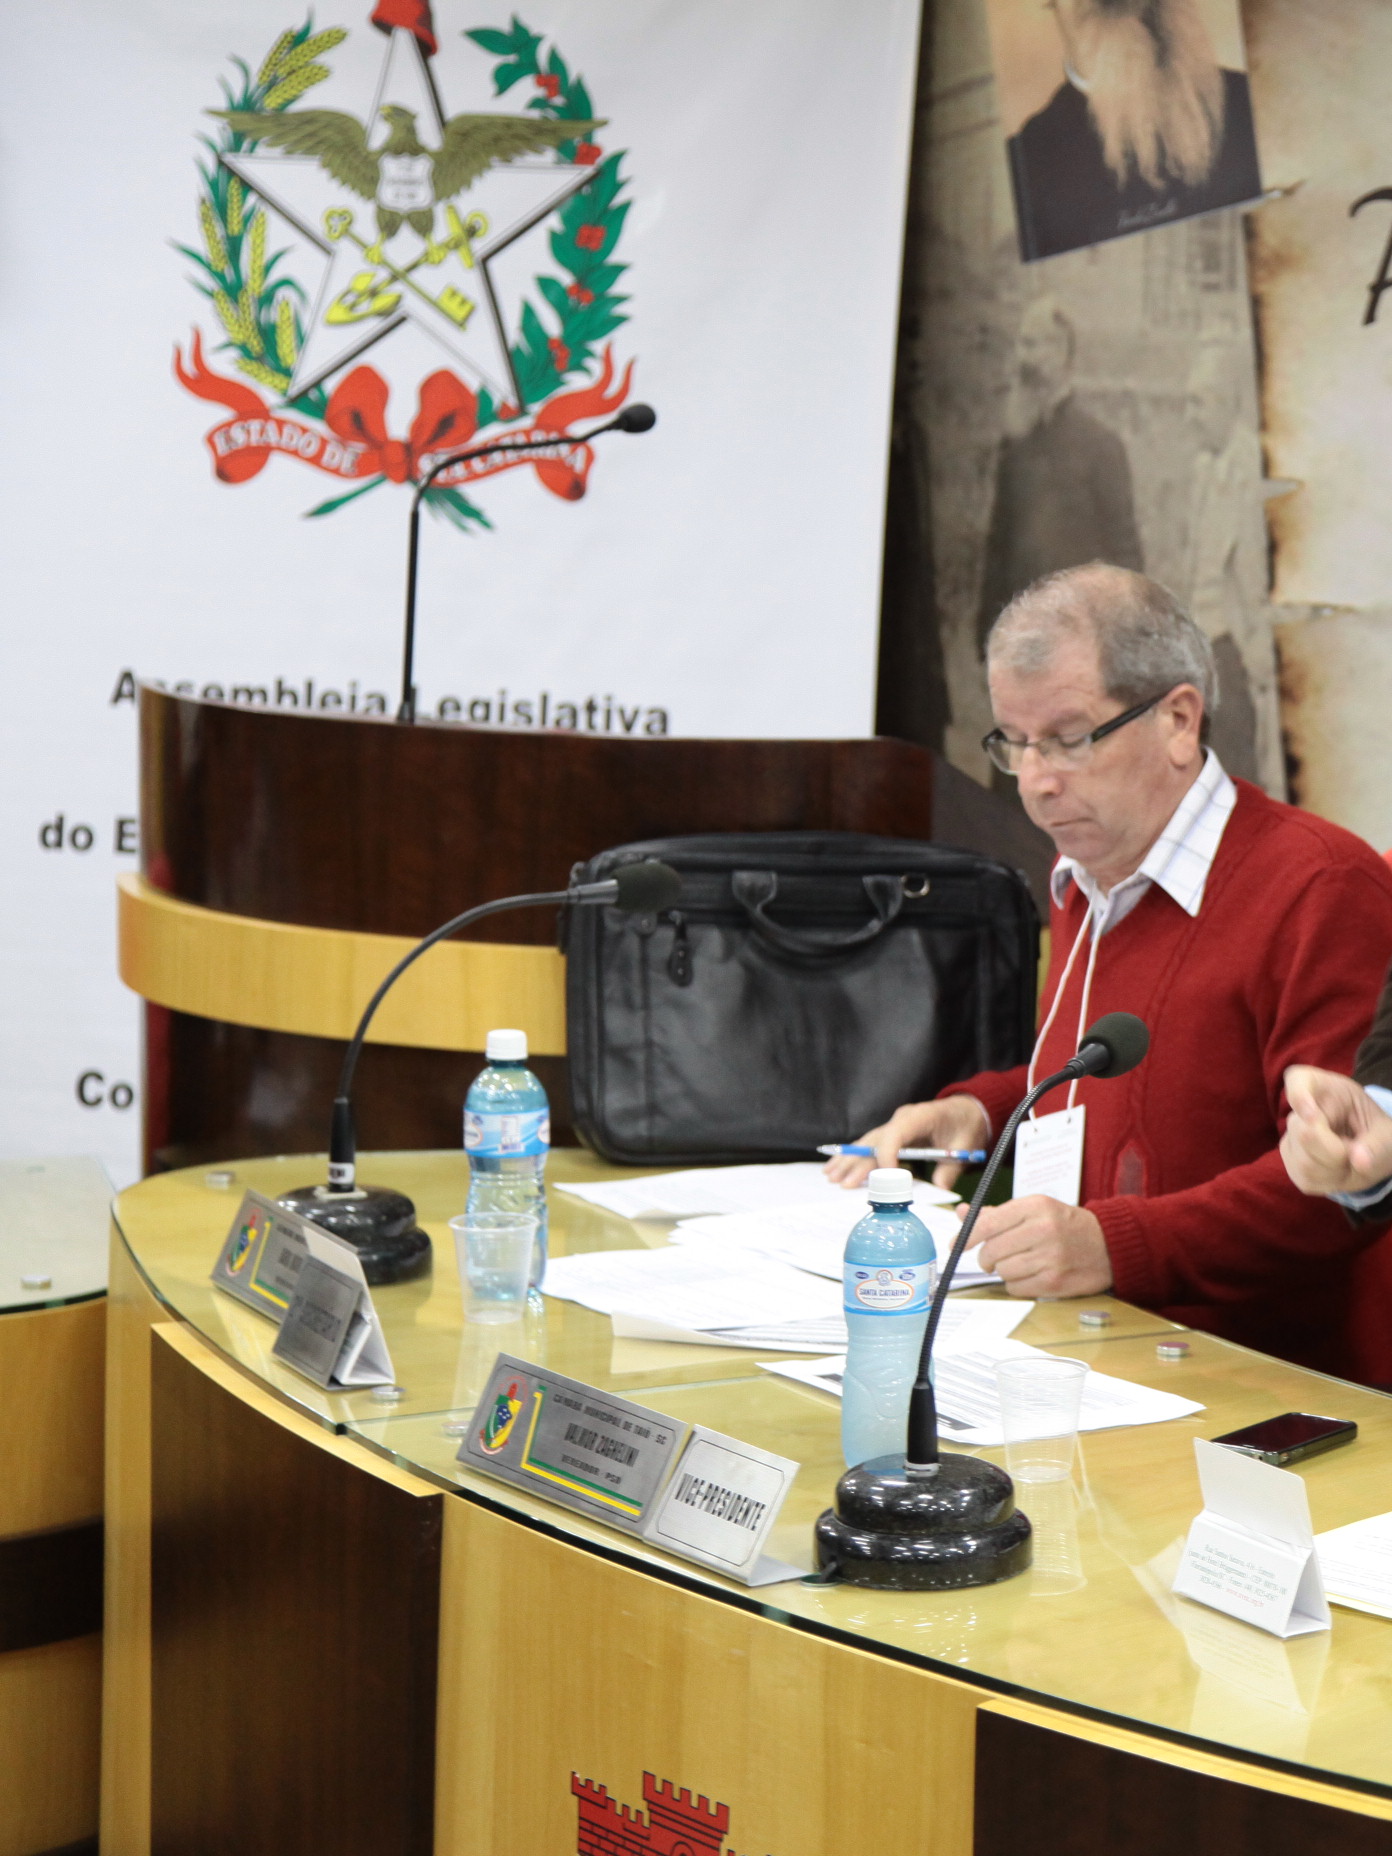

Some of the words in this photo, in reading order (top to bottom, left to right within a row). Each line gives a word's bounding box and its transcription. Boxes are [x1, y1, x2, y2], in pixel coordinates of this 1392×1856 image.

[214, 418, 324, 458] ESTADO
[110, 670, 388, 715] Aembleia
[41, 815, 93, 851] do
[674, 1472, 767, 1532] VICE-PRESIDENTE
